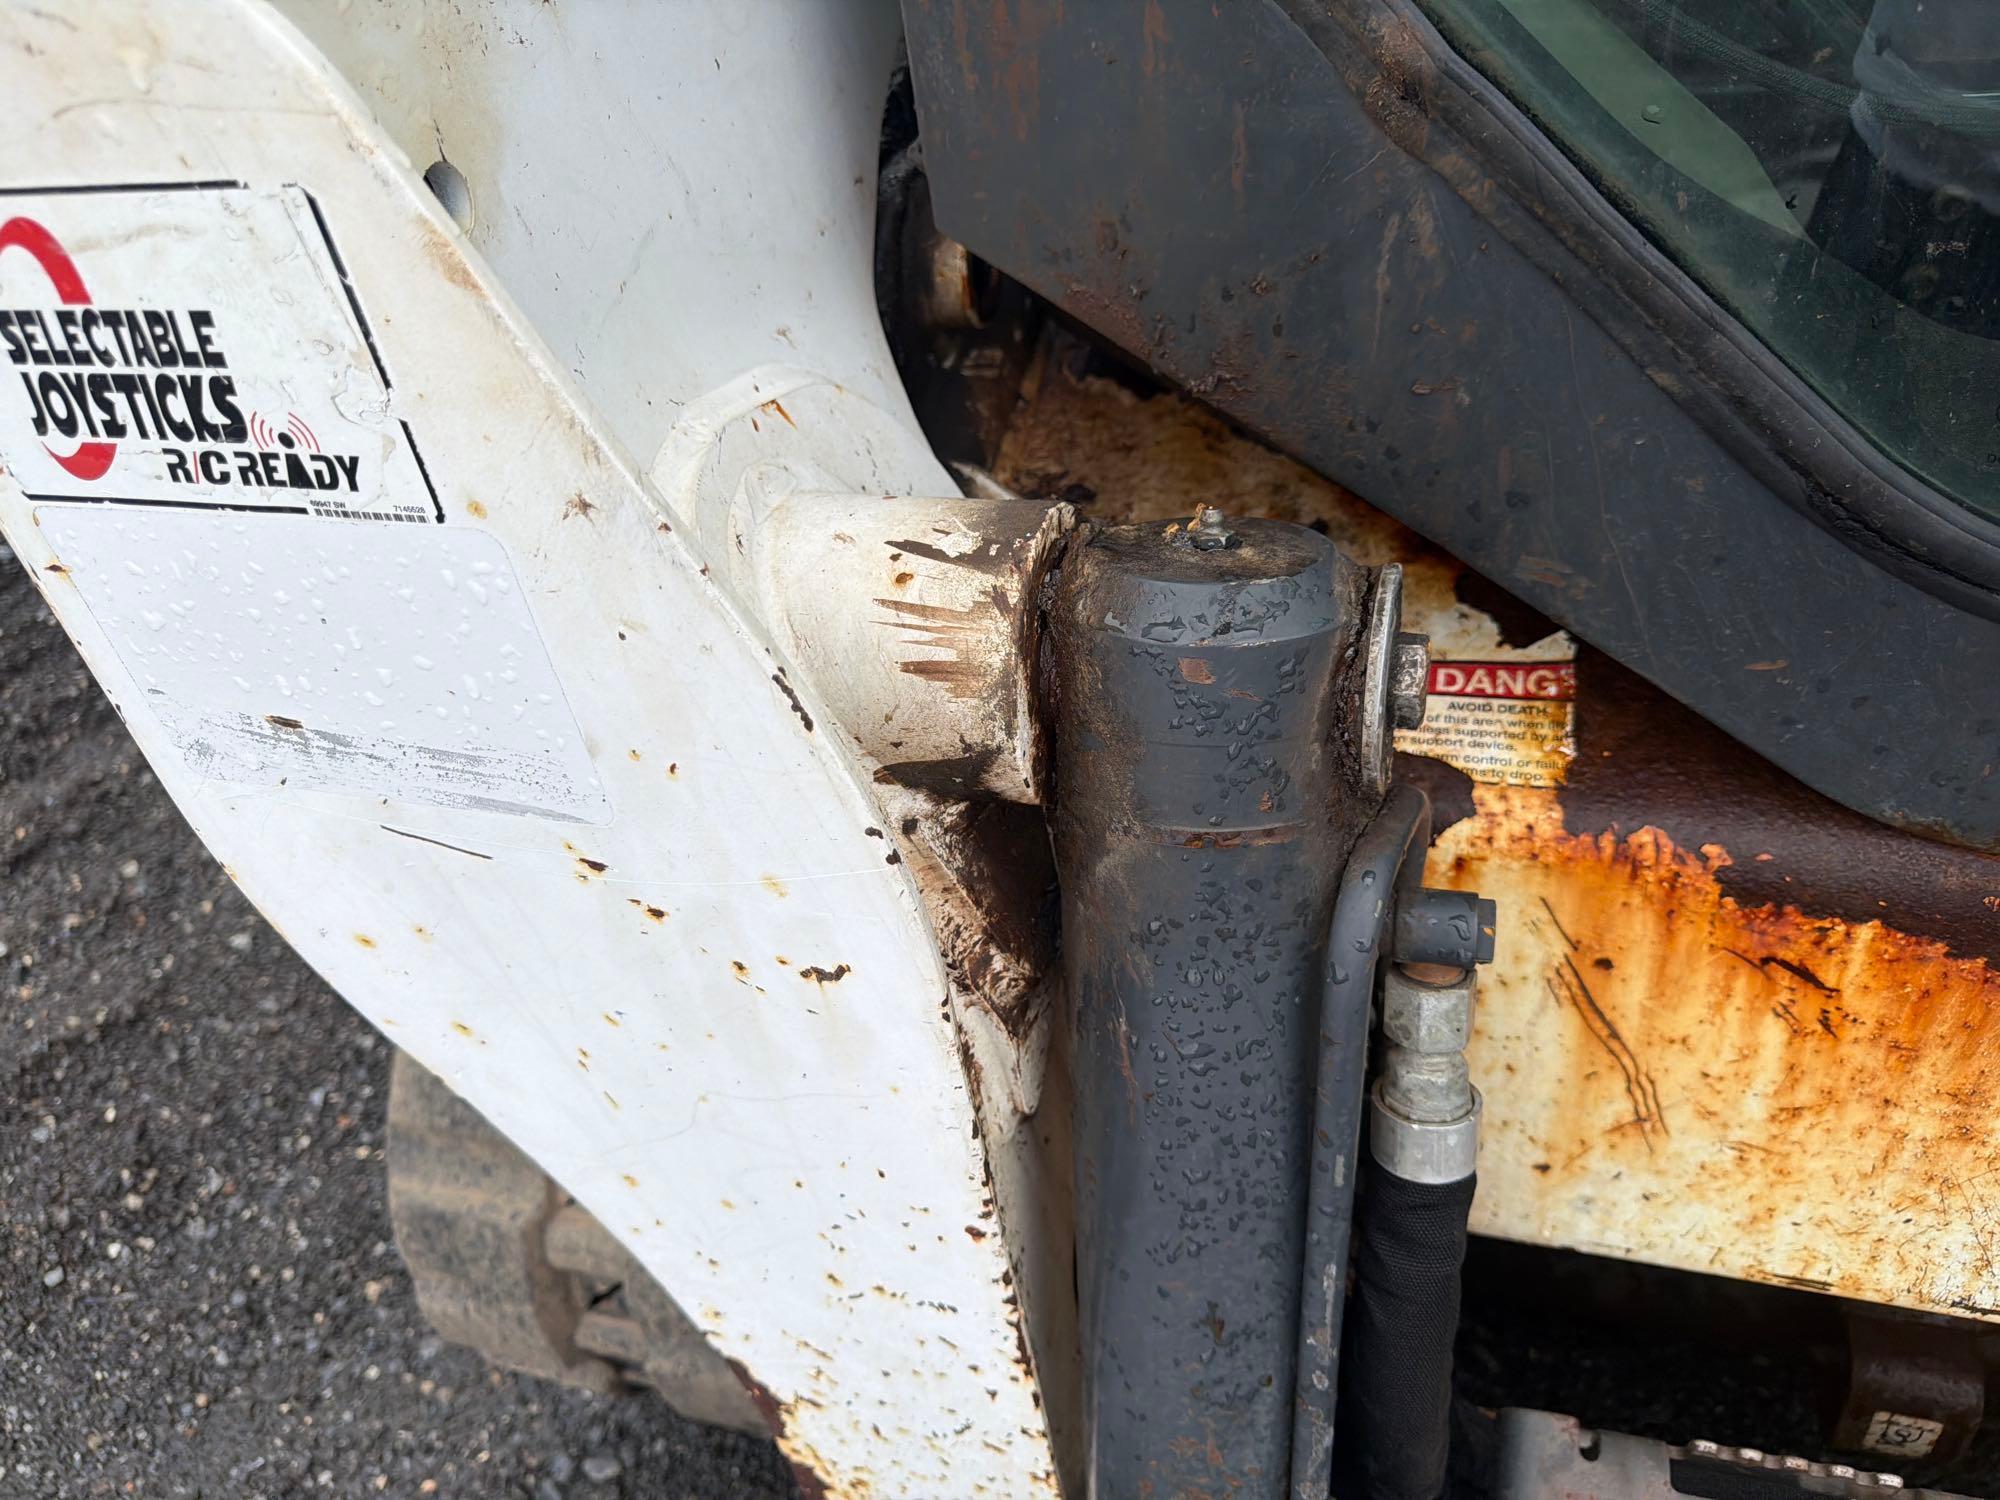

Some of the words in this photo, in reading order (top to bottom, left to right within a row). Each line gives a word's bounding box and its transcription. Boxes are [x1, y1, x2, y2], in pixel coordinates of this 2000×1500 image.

[0, 309, 228, 368] SELECTABLE
[20, 371, 248, 443] JOYSTICKS
[162, 448, 232, 485] R/C
[233, 451, 360, 492] READY
[1447, 702, 1492, 713] AVOID
[1426, 714, 1442, 723] of
[1444, 714, 1468, 724] this
[1507, 719, 1544, 729] when
[1410, 736, 1464, 747] support
[1455, 728, 1526, 741] supported
[1531, 730, 1547, 744] by
[1463, 754, 1513, 767] control
[1516, 759, 1532, 769] or
[1491, 768, 1506, 778] to
